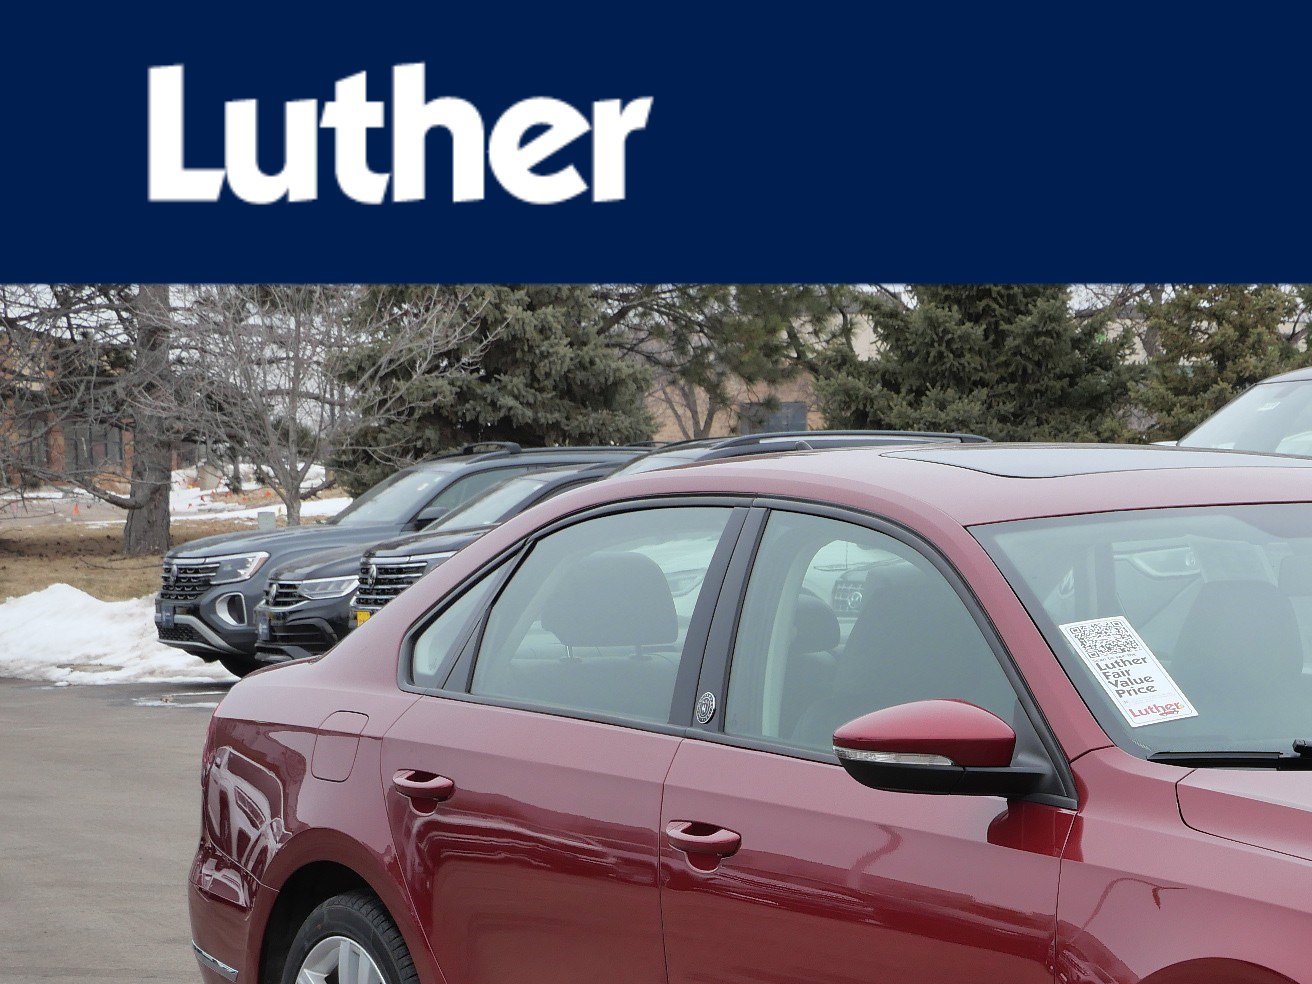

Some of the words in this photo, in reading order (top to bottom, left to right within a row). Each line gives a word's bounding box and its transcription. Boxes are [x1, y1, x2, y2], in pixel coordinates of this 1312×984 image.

[1096, 656, 1148, 671] Luther
[1102, 669, 1131, 681] Fair
[1108, 675, 1155, 689] Value
[1115, 685, 1157, 699] Price
[1128, 701, 1182, 718] Luther
